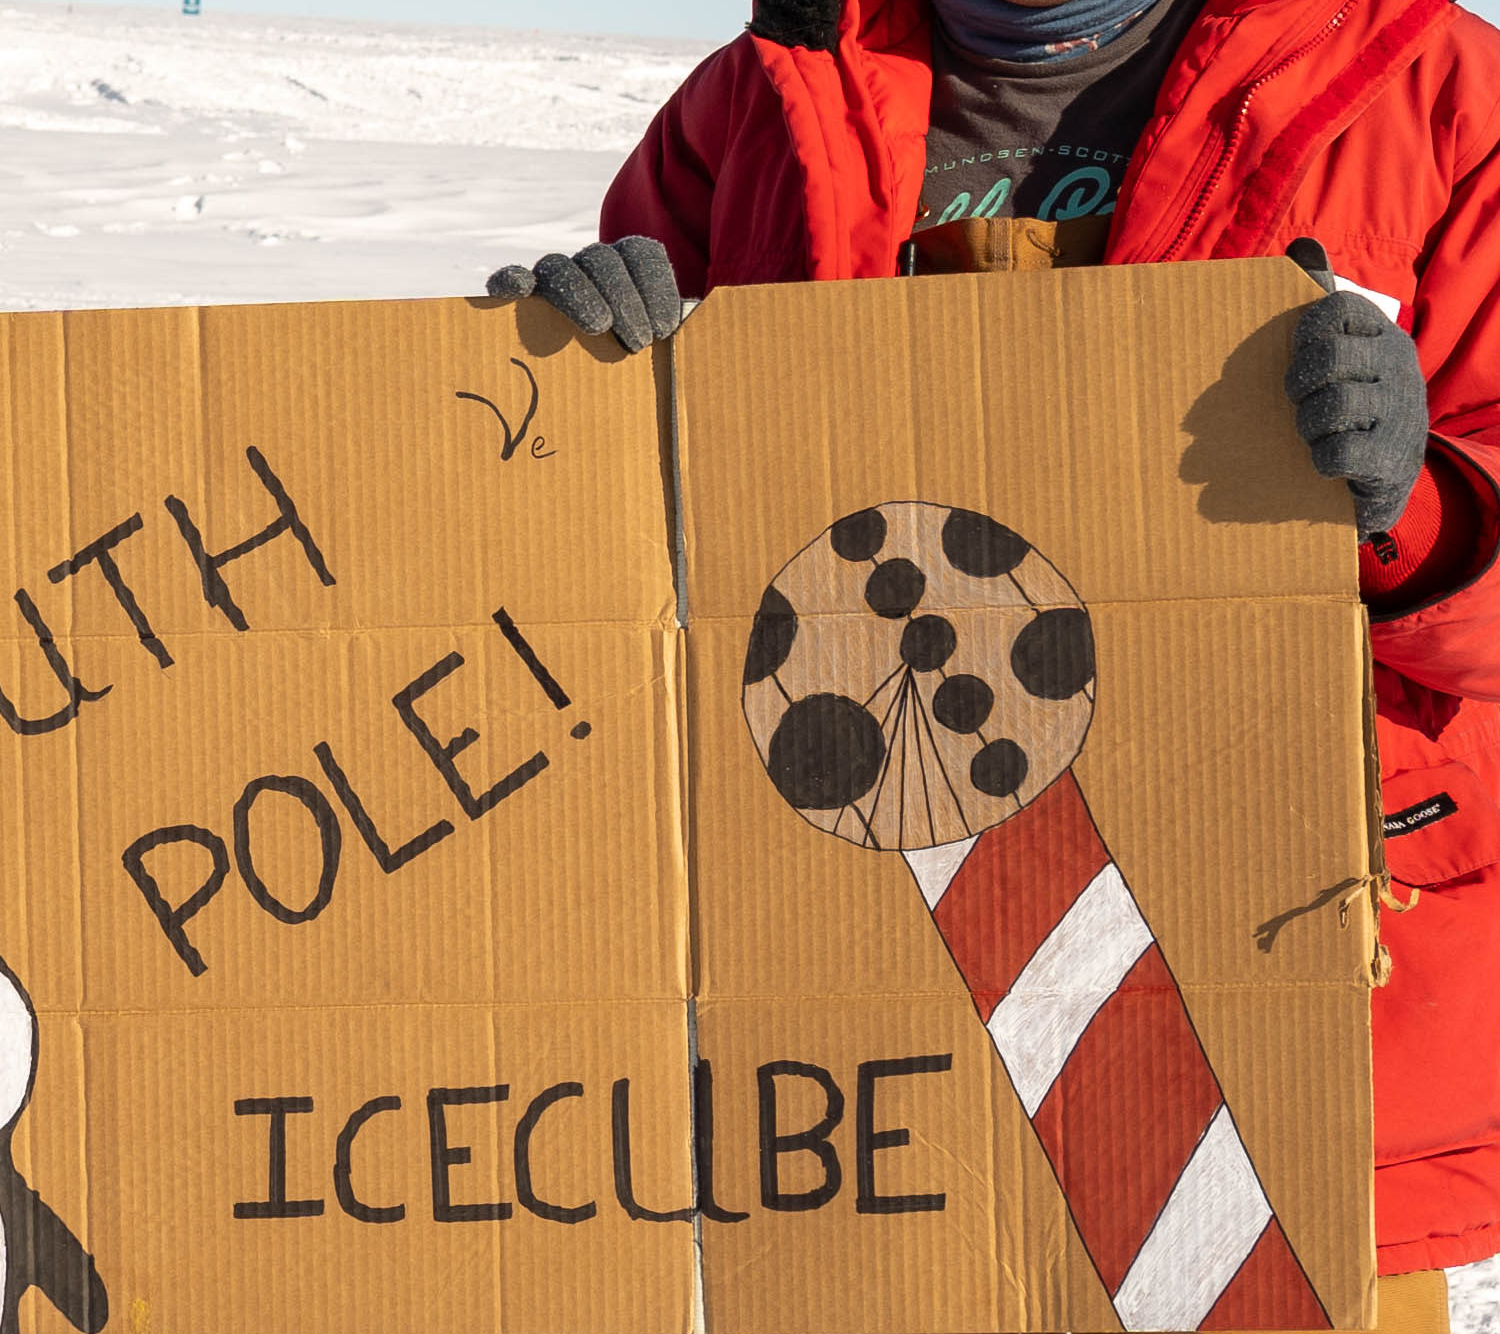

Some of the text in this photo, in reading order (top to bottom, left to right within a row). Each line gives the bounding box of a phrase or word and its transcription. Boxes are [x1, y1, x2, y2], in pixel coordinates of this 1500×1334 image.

[924, 145, 1129, 176] MUNDSEN-SCOT
[121, 607, 593, 977] POLE!
[1406, 804, 1441, 825] GOOSE
[233, 1053, 953, 1225] ICECUBE
